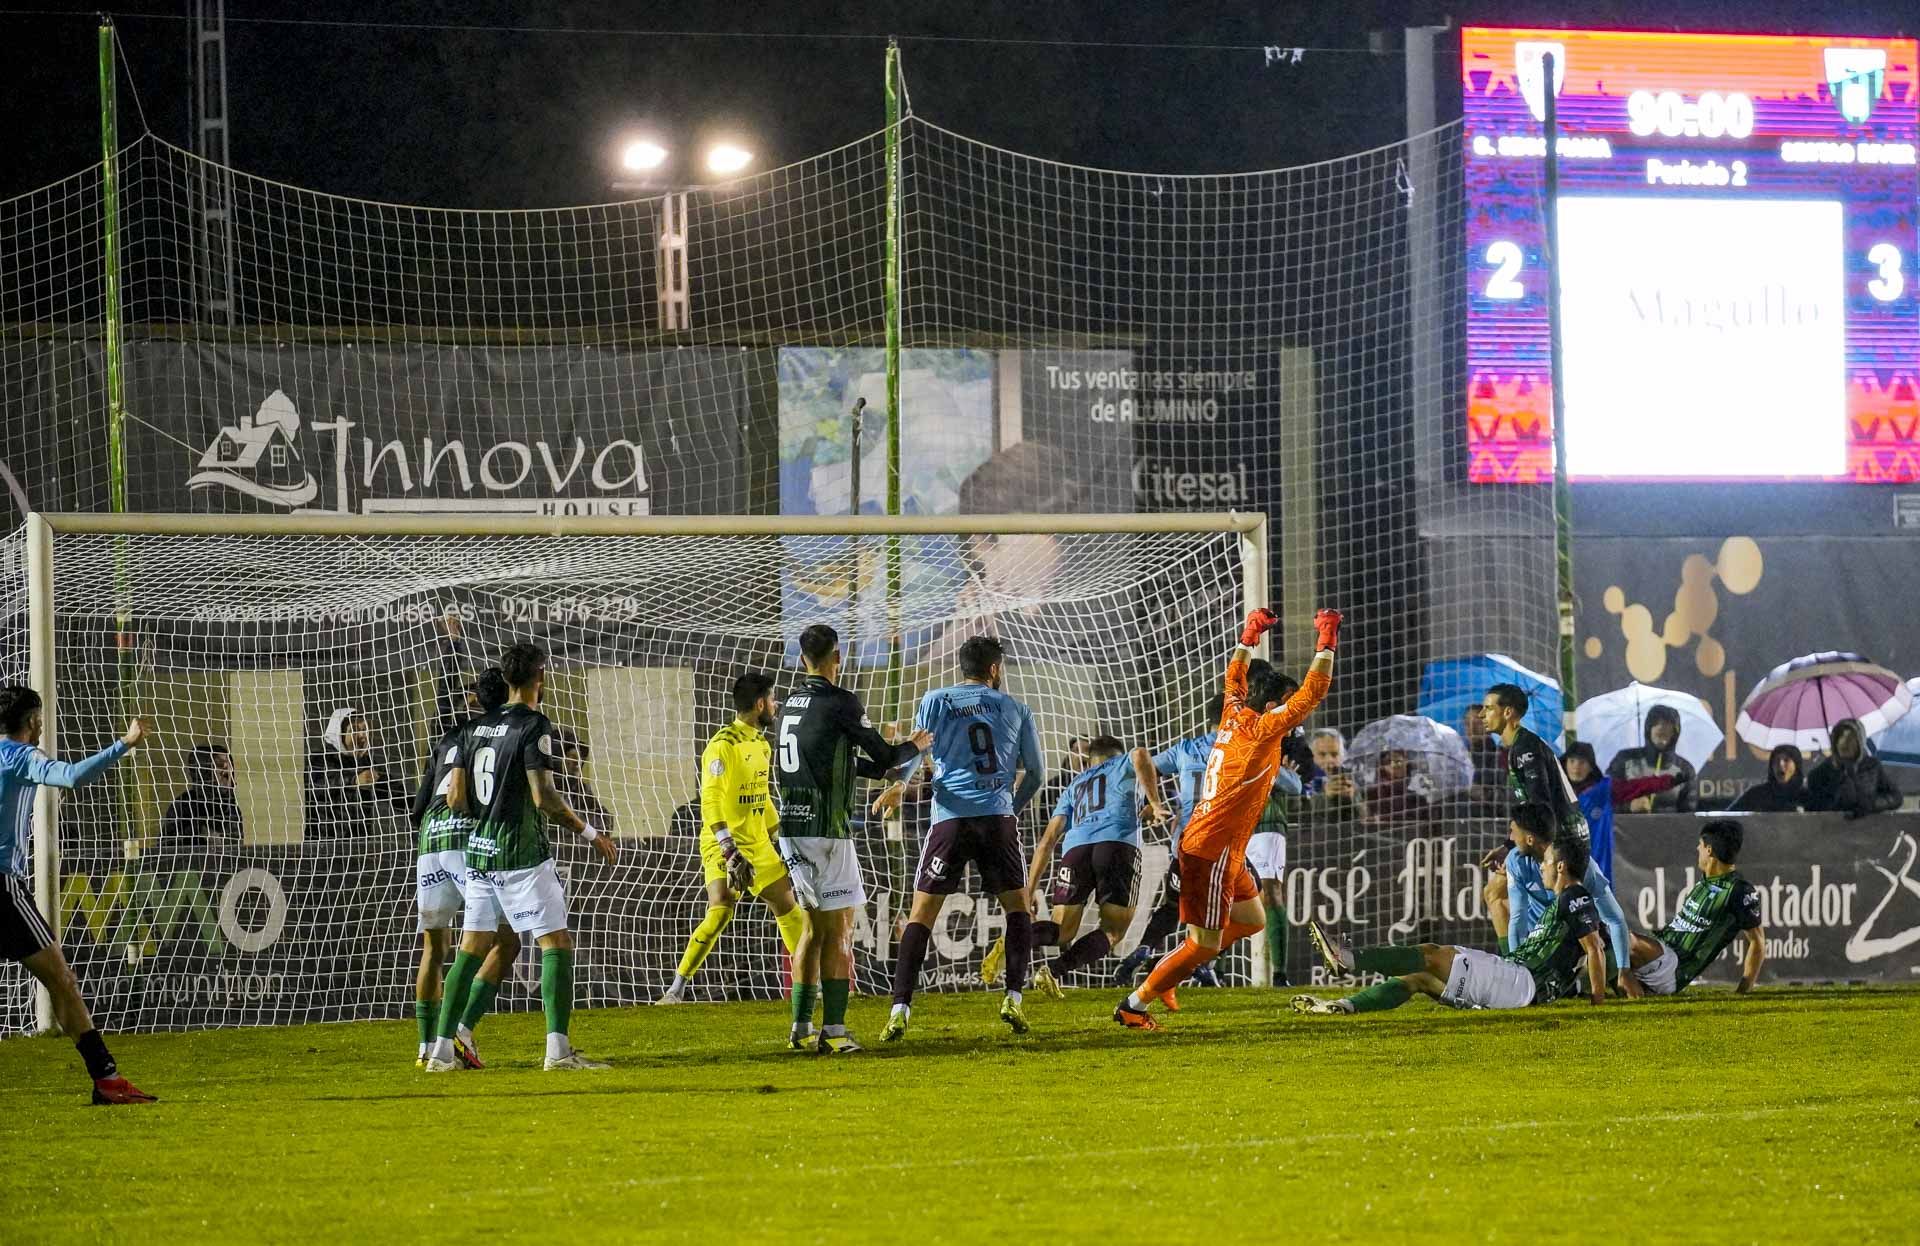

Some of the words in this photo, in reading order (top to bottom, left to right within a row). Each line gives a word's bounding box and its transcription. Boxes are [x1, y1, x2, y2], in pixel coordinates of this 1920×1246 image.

[1627, 90, 1754, 138] 90:00
[1647, 159, 1729, 186] Periodo
[1732, 161, 1747, 186] 2
[1485, 241, 1524, 299] 2
[1868, 244, 1904, 301] 3
[1046, 366, 1081, 389] Tus
[1085, 368, 1172, 390] ventanas
[1178, 366, 1257, 394] siempre
[1091, 397, 1115, 422] de
[779, 715, 802, 773] 5
[968, 722, 997, 774] 9
[473, 746, 496, 806] 6
[1287, 850, 1371, 927] osé
[1638, 867, 1666, 930] el
[1733, 938, 1744, 965] y
[1764, 930, 1810, 959] andas
